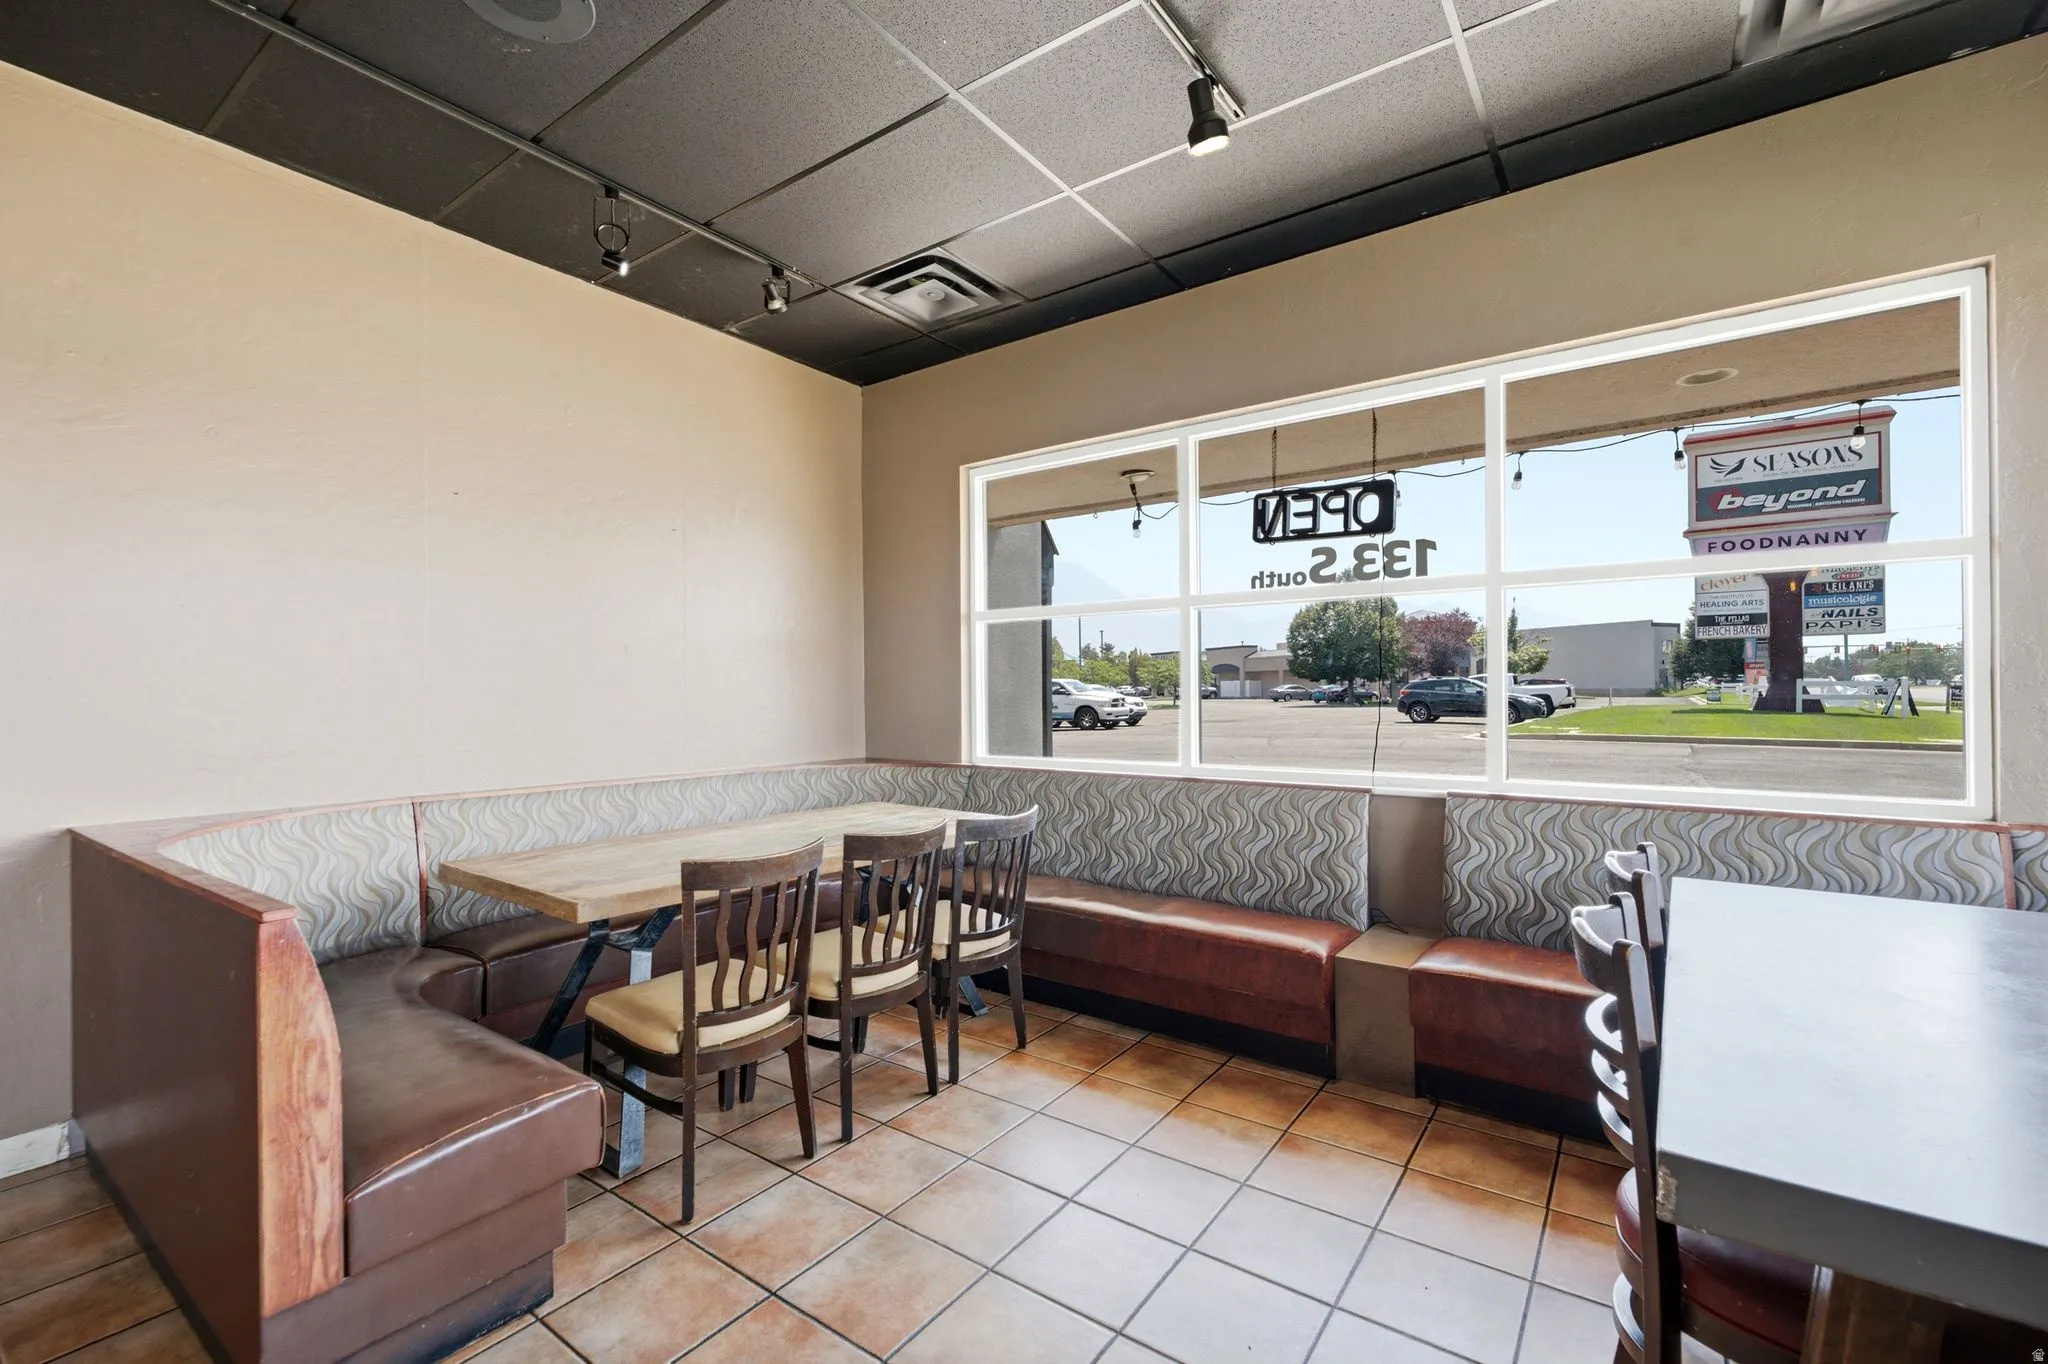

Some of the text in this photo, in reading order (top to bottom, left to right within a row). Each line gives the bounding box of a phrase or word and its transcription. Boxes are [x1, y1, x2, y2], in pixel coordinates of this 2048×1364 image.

[1753, 443, 1864, 473] SEASONS
[1716, 479, 1867, 512] beyond
[1707, 528, 1869, 553] FOODNANNY
[1825, 580, 1875, 592] LEILANI'S
[1700, 598, 1765, 608] HEALING ARTS
[1808, 594, 1878, 606] musicologie
[1821, 607, 1879, 618] NAILS
[1697, 624, 1767, 636] FRENCH BAKERY
[1805, 619, 1884, 630] PAPI'S
